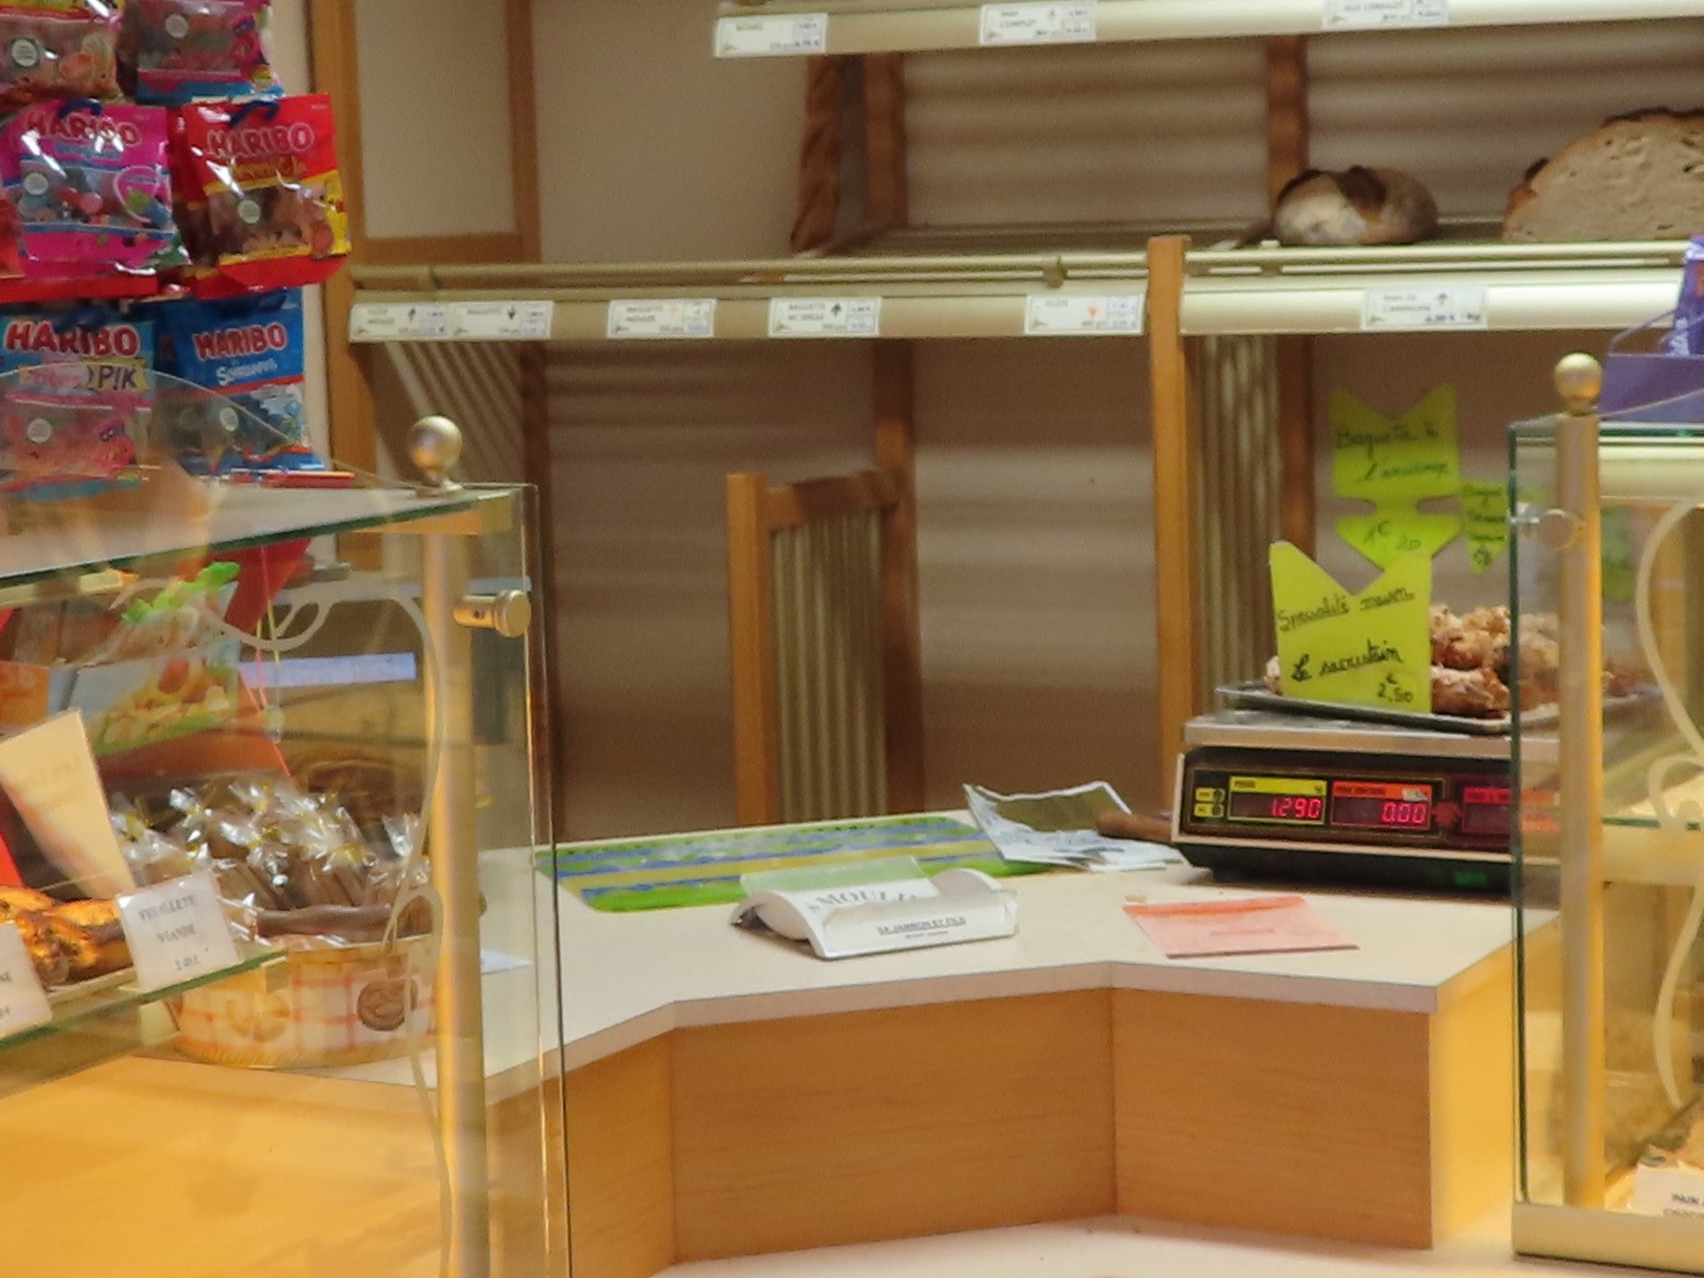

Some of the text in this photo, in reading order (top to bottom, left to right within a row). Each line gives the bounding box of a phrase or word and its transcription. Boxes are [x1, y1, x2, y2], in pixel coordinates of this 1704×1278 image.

[208, 123, 314, 160] HARIBO
[5, 320, 139, 358] HARIBO
[193, 323, 288, 361] HARIBO
